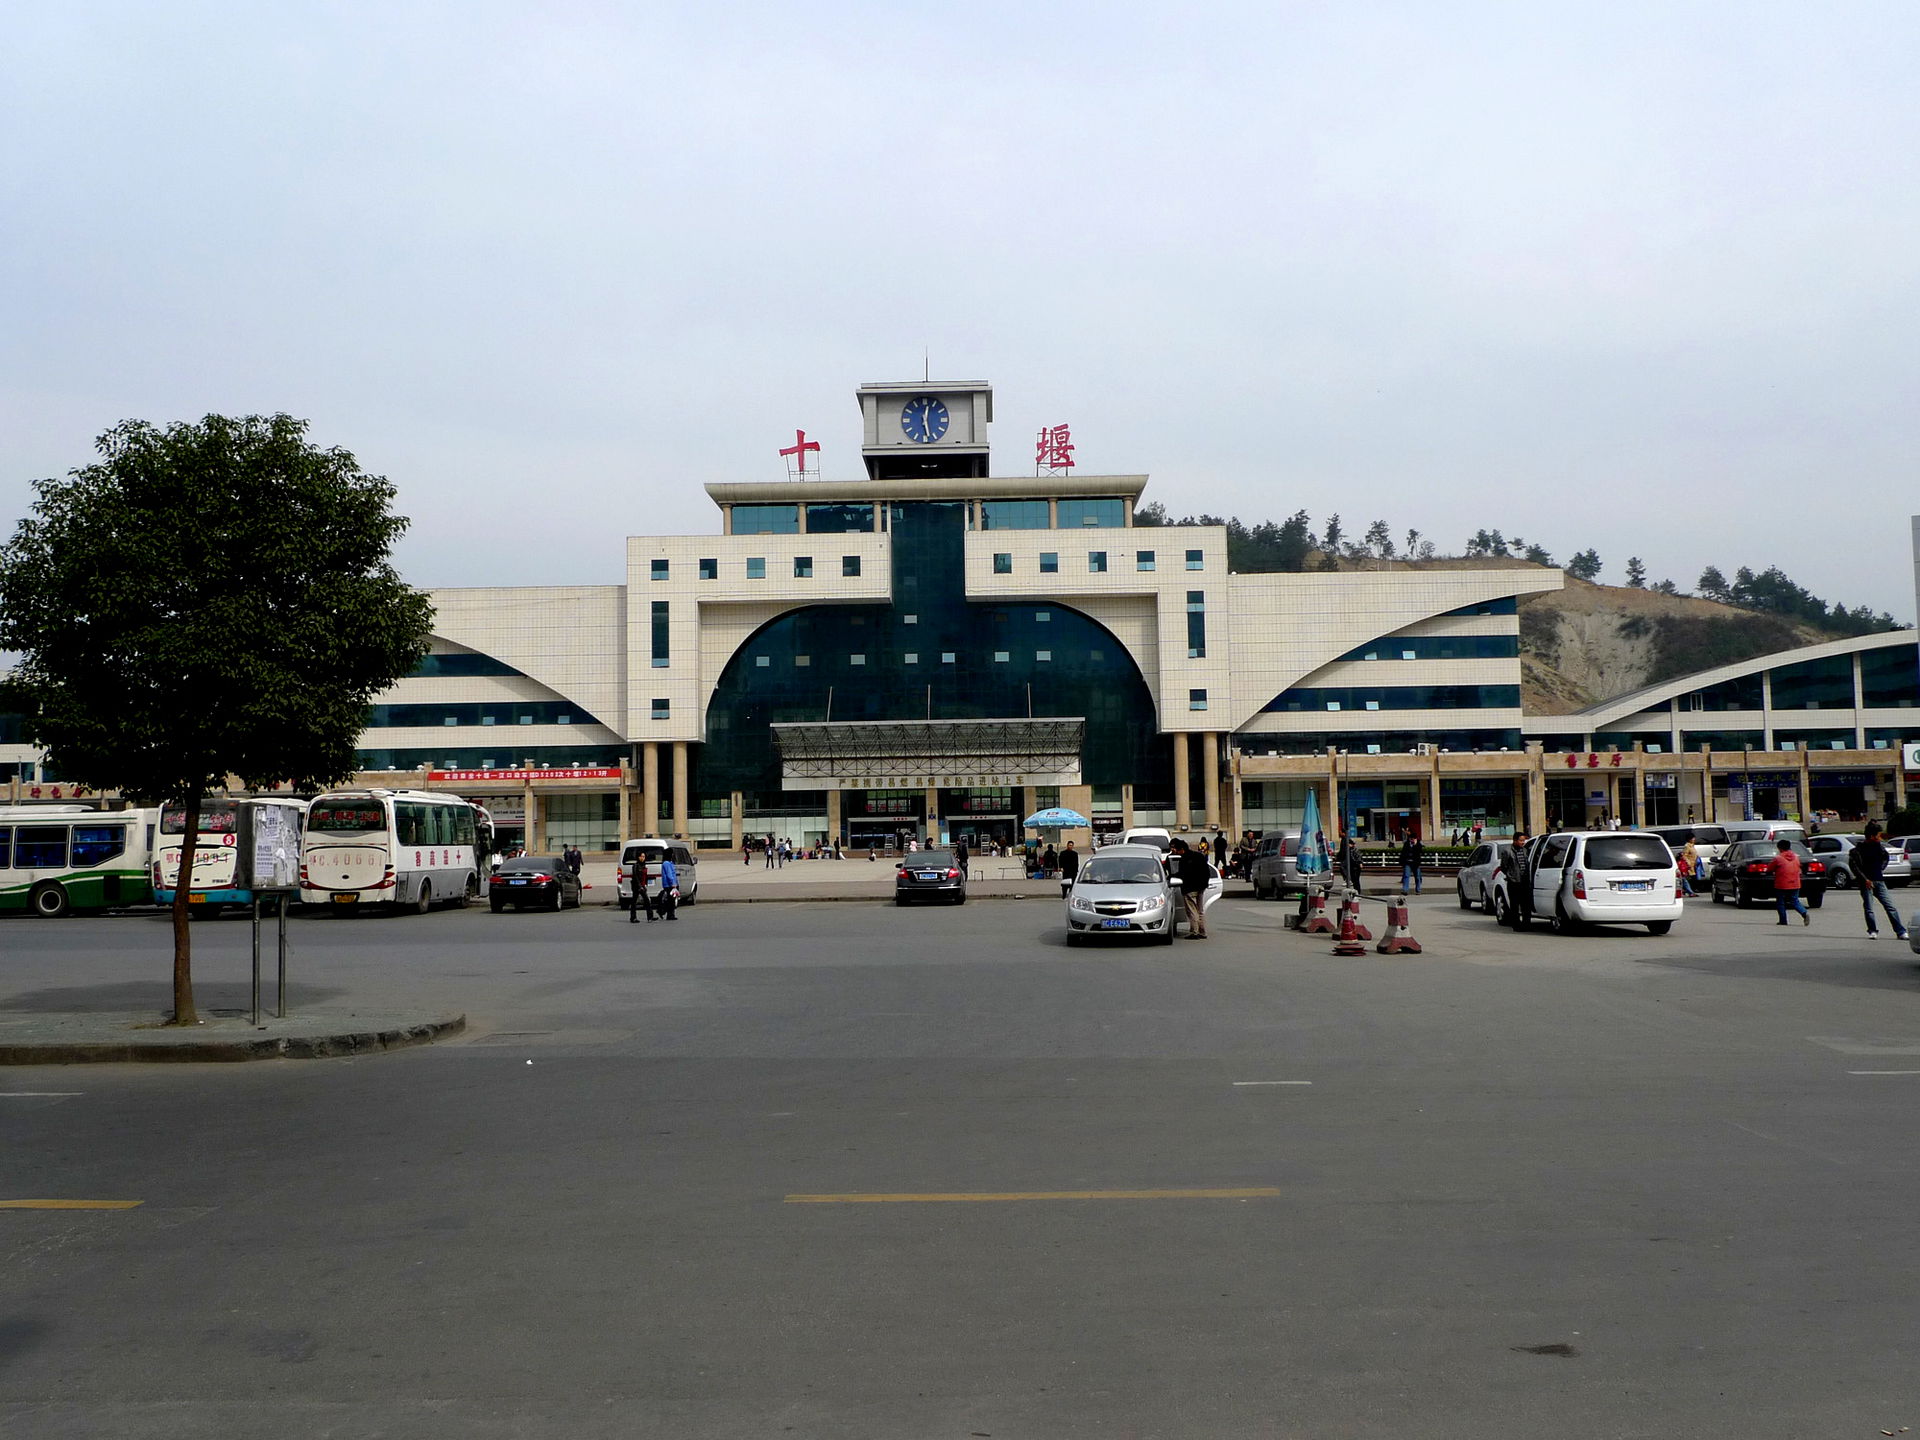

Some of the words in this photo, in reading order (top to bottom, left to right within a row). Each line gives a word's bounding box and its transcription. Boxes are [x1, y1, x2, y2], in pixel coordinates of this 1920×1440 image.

[779, 429, 821, 472] 十
[1035, 423, 1075, 468] 堰
[1565, 753, 1622, 768] 售票厅
